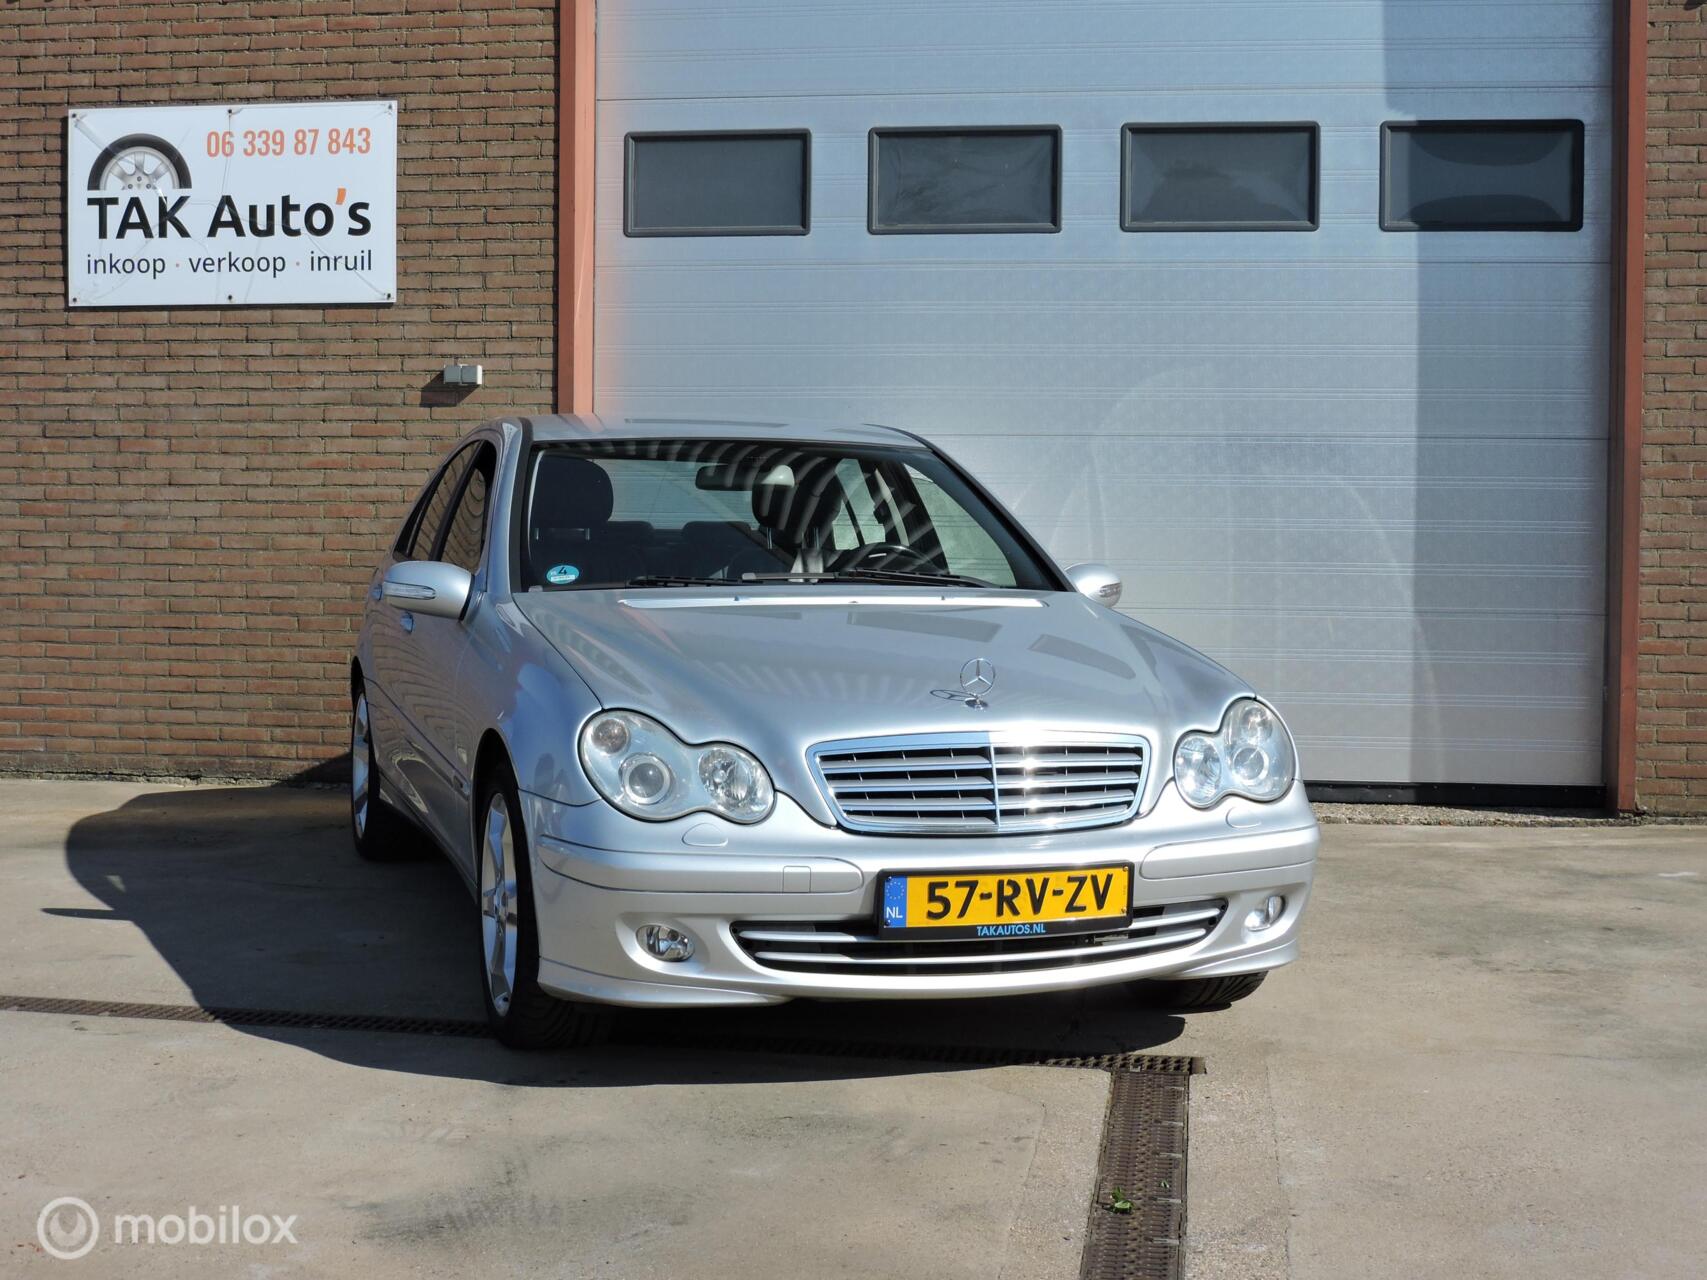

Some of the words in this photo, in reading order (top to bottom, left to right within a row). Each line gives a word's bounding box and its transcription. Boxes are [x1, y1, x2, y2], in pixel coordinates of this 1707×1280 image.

[207, 131, 234, 158] 06
[243, 129, 285, 157] 339
[294, 128, 320, 156] 87
[327, 127, 371, 154] 843
[87, 196, 191, 240] TAK
[206, 187, 372, 238] Auto's
[86, 253, 166, 280] inkoop
[188, 251, 286, 278] verkoop
[310, 250, 372, 271] inruil
[926, 873, 1114, 920] 57-RV-ZV
[886, 906, 903, 919] NL
[976, 923, 1046, 937] TAKAUTOS.NL
